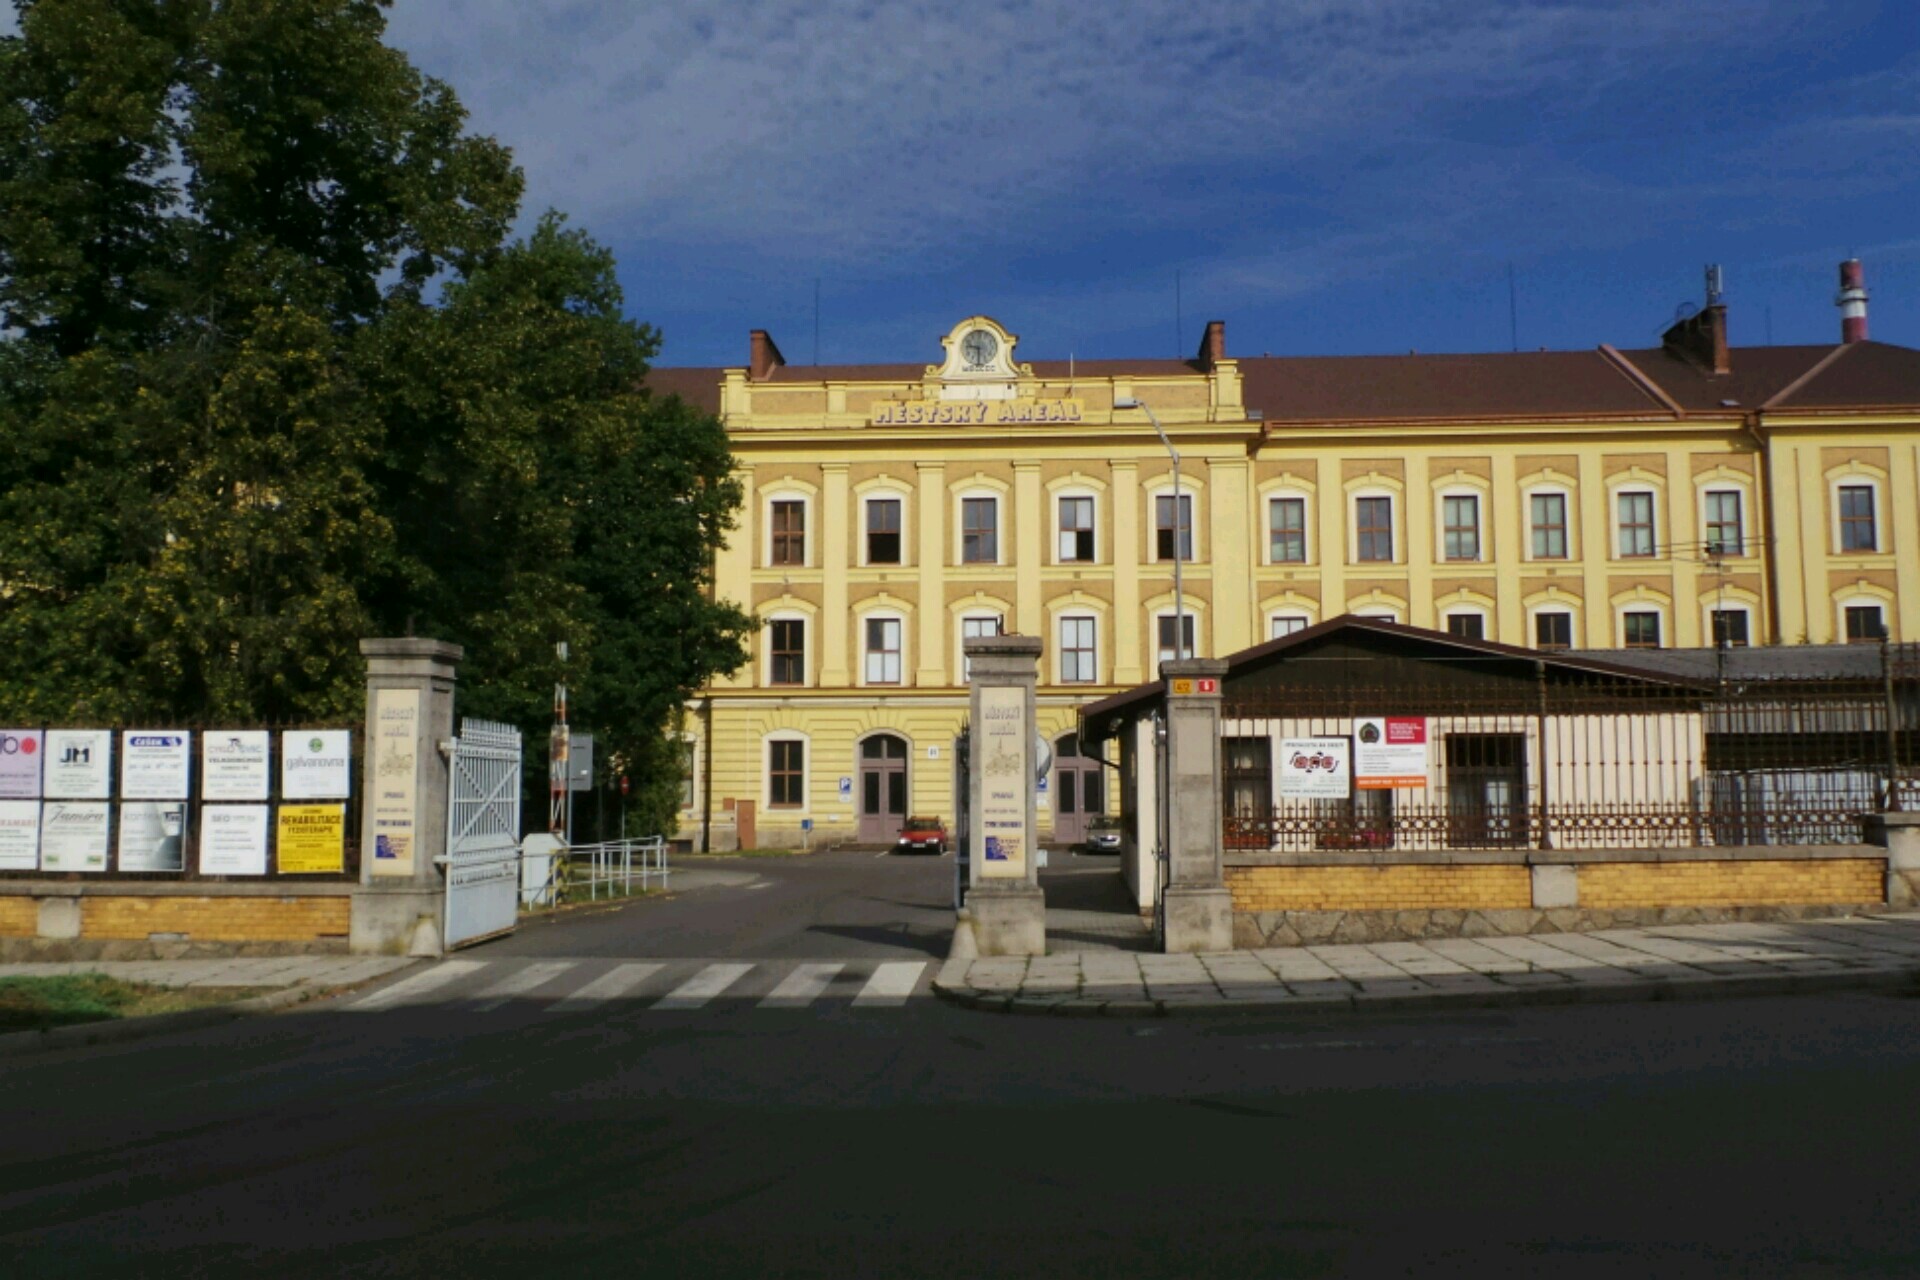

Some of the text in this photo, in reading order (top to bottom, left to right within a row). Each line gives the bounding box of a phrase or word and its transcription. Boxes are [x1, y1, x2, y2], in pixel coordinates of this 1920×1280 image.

[875, 400, 1082, 423] MĚSTSKÝ AREÁL
[60, 748, 90, 762] JM
[286, 755, 344, 770] galvanovna
[280, 815, 341, 825] REHABILITACE
